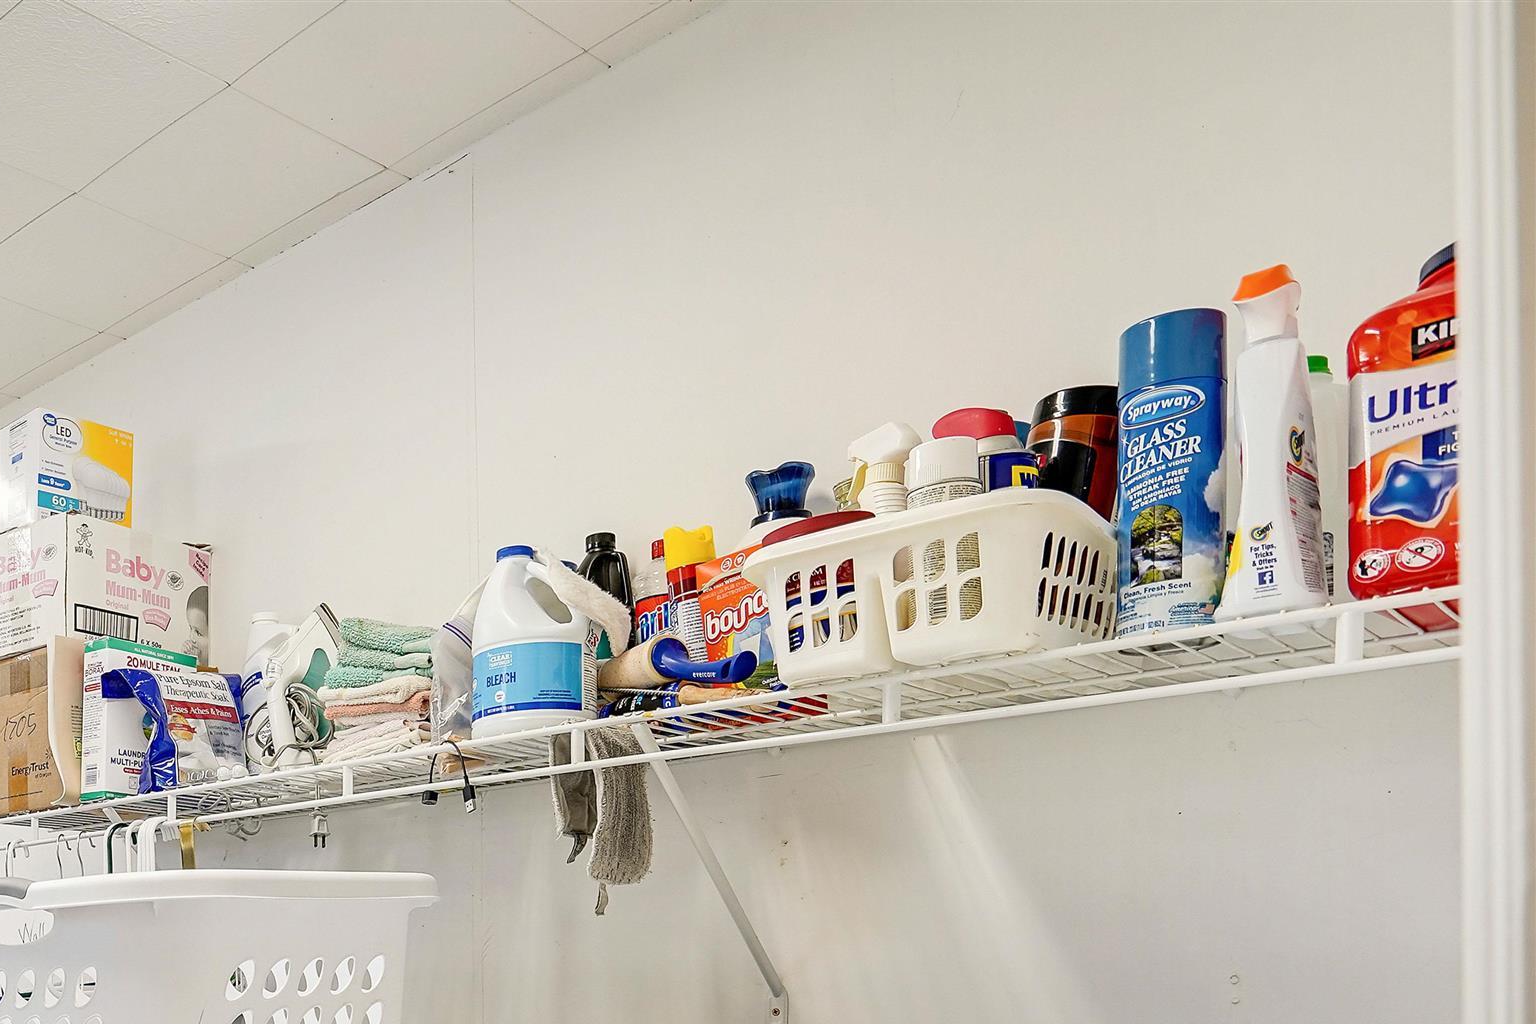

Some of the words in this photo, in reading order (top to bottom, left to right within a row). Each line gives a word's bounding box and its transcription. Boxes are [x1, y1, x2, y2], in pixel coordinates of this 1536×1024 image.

[1128, 395, 1192, 421] Sprayway
[1368, 380, 1457, 423] Ultr
[1370, 417, 1424, 436] PREMIUM
[1433, 408, 1458, 419] LAU
[56, 425, 72, 438] LED
[1127, 419, 1186, 458] GLASS
[1120, 436, 1201, 483] CLEANER
[1168, 457, 1192, 467] VIDRIO
[1127, 475, 1164, 496] AMMONIA
[1166, 467, 1189, 478] FREE
[1129, 483, 1159, 501] STREAK
[1162, 475, 1185, 486] FREE
[52, 496, 67, 506] 60
[1250, 545, 1259, 553] For
[1255, 551, 1273, 559] Tricks
[106, 548, 165, 590] Baby
[106, 580, 171, 609] Mum-Mum
[1124, 590, 1142, 599] Clean,
[1144, 585, 1165, 594] Fresh
[106, 600, 129, 611] Original
[705, 591, 768, 643] bounc
[127, 656, 139, 668] 20
[140, 659, 160, 671] MULE
[157, 673, 179, 685] Pure
[181, 676, 210, 690] Epsom
[211, 680, 227, 692] Salt
[486, 671, 516, 688] BLEACH
[165, 685, 209, 700] Therapeutic
[210, 691, 229, 703] Soak
[170, 705, 188, 714] Eases
[190, 707, 209, 716] Aches
[4, 713, 37, 741] 1705
[111, 757, 143, 768] MULTI-PU
[118, 749, 145, 760] LAUNDR
